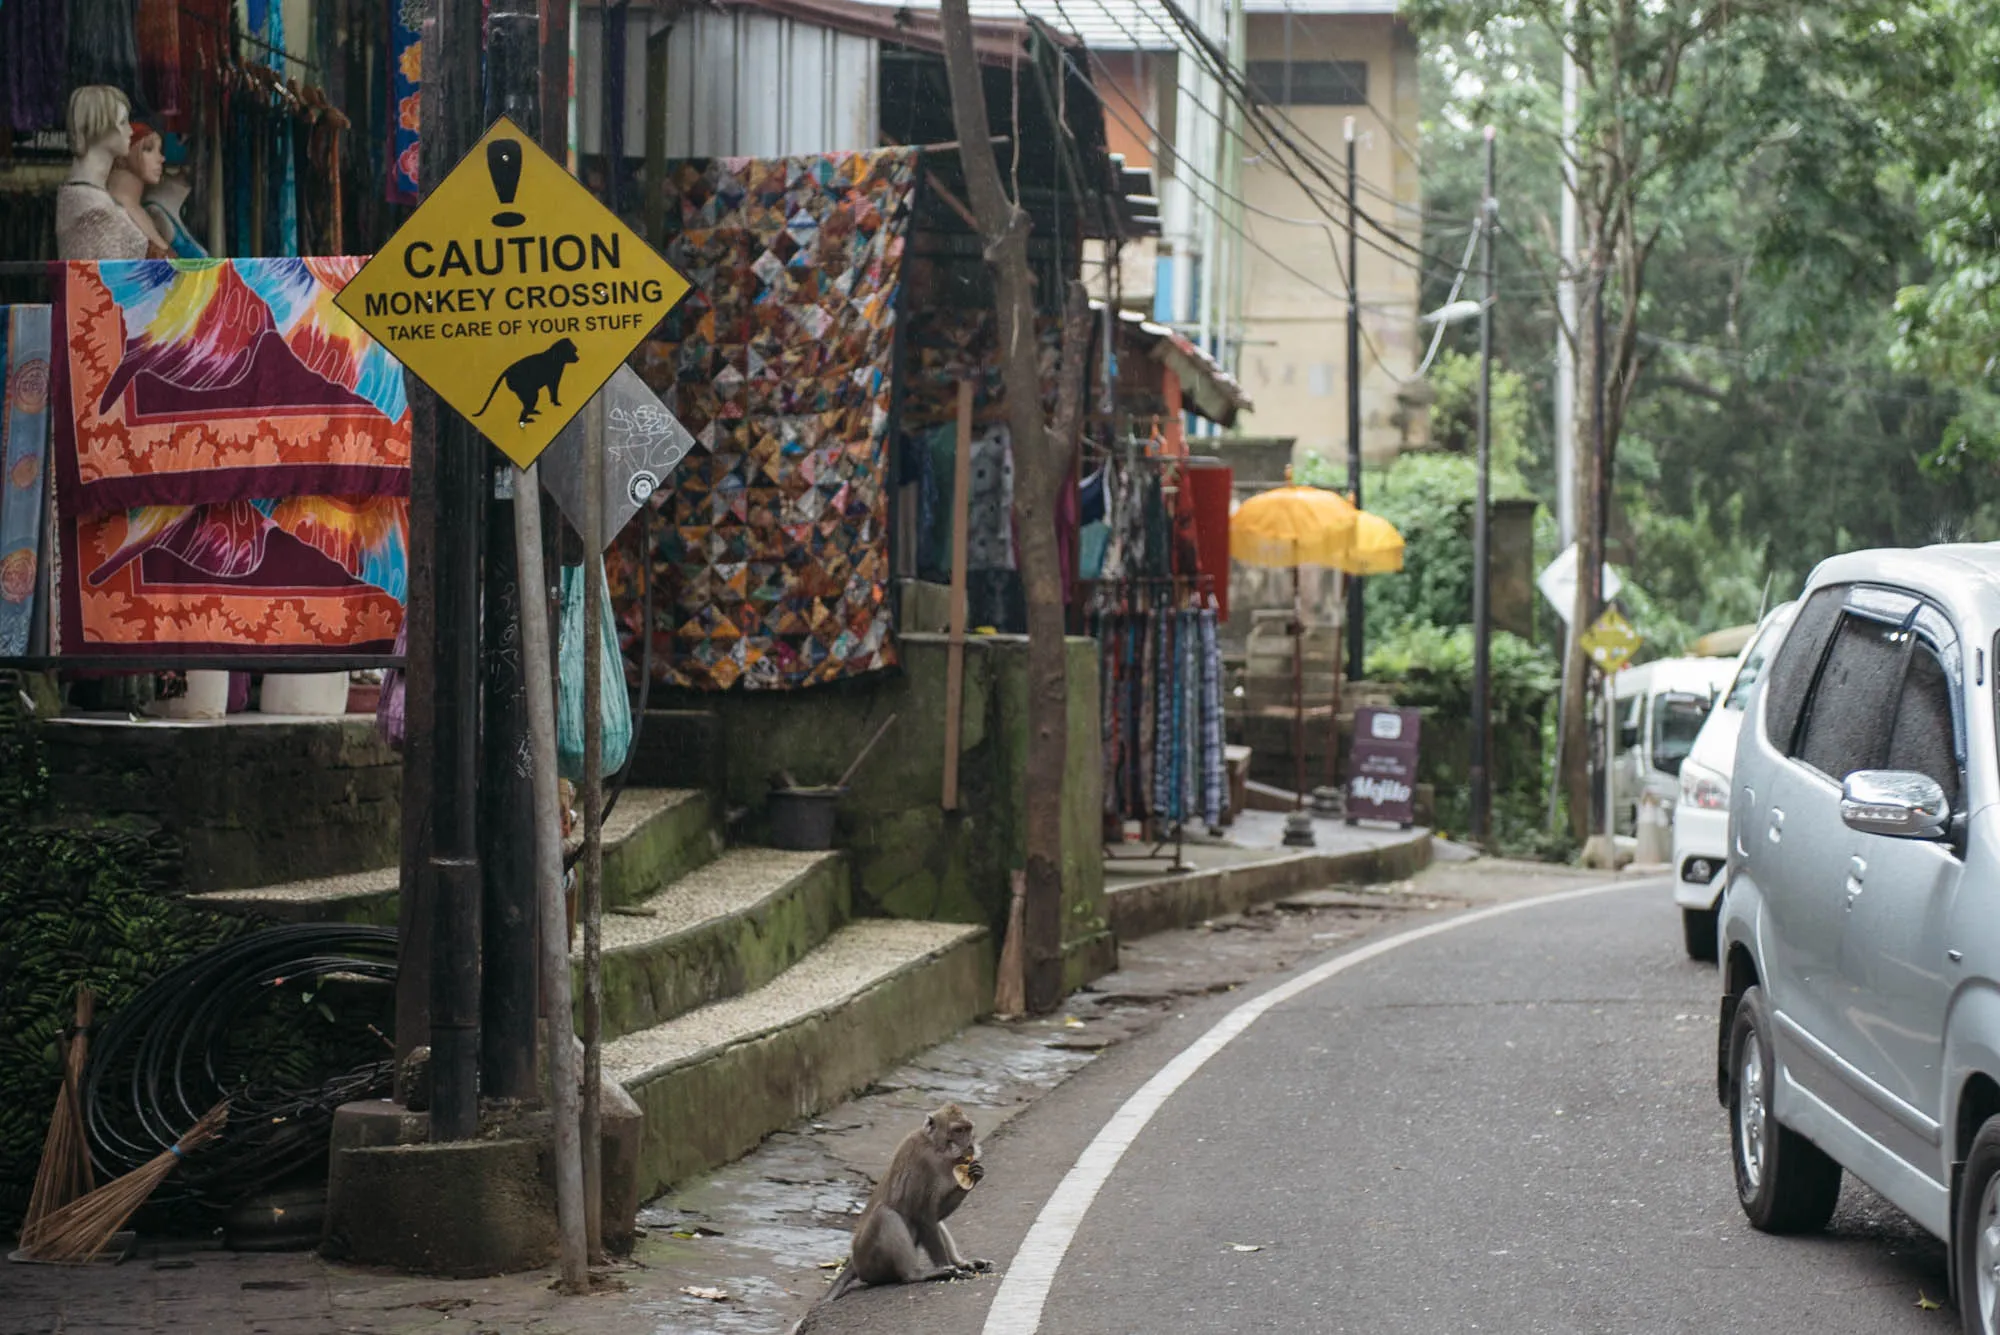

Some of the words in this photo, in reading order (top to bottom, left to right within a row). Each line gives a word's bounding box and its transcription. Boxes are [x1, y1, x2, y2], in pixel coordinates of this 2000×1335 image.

[36, 130, 69, 150] FAMIL
[403, 232, 621, 279] CAUTION
[364, 287, 496, 317] MONKEY
[505, 279, 663, 311] CROSSING
[387, 323, 436, 341] TAKE
[441, 321, 492, 339] CARE
[497, 319, 522, 336] OF
[527, 317, 580, 335] YOUR
[585, 313, 643, 332] STUFF
